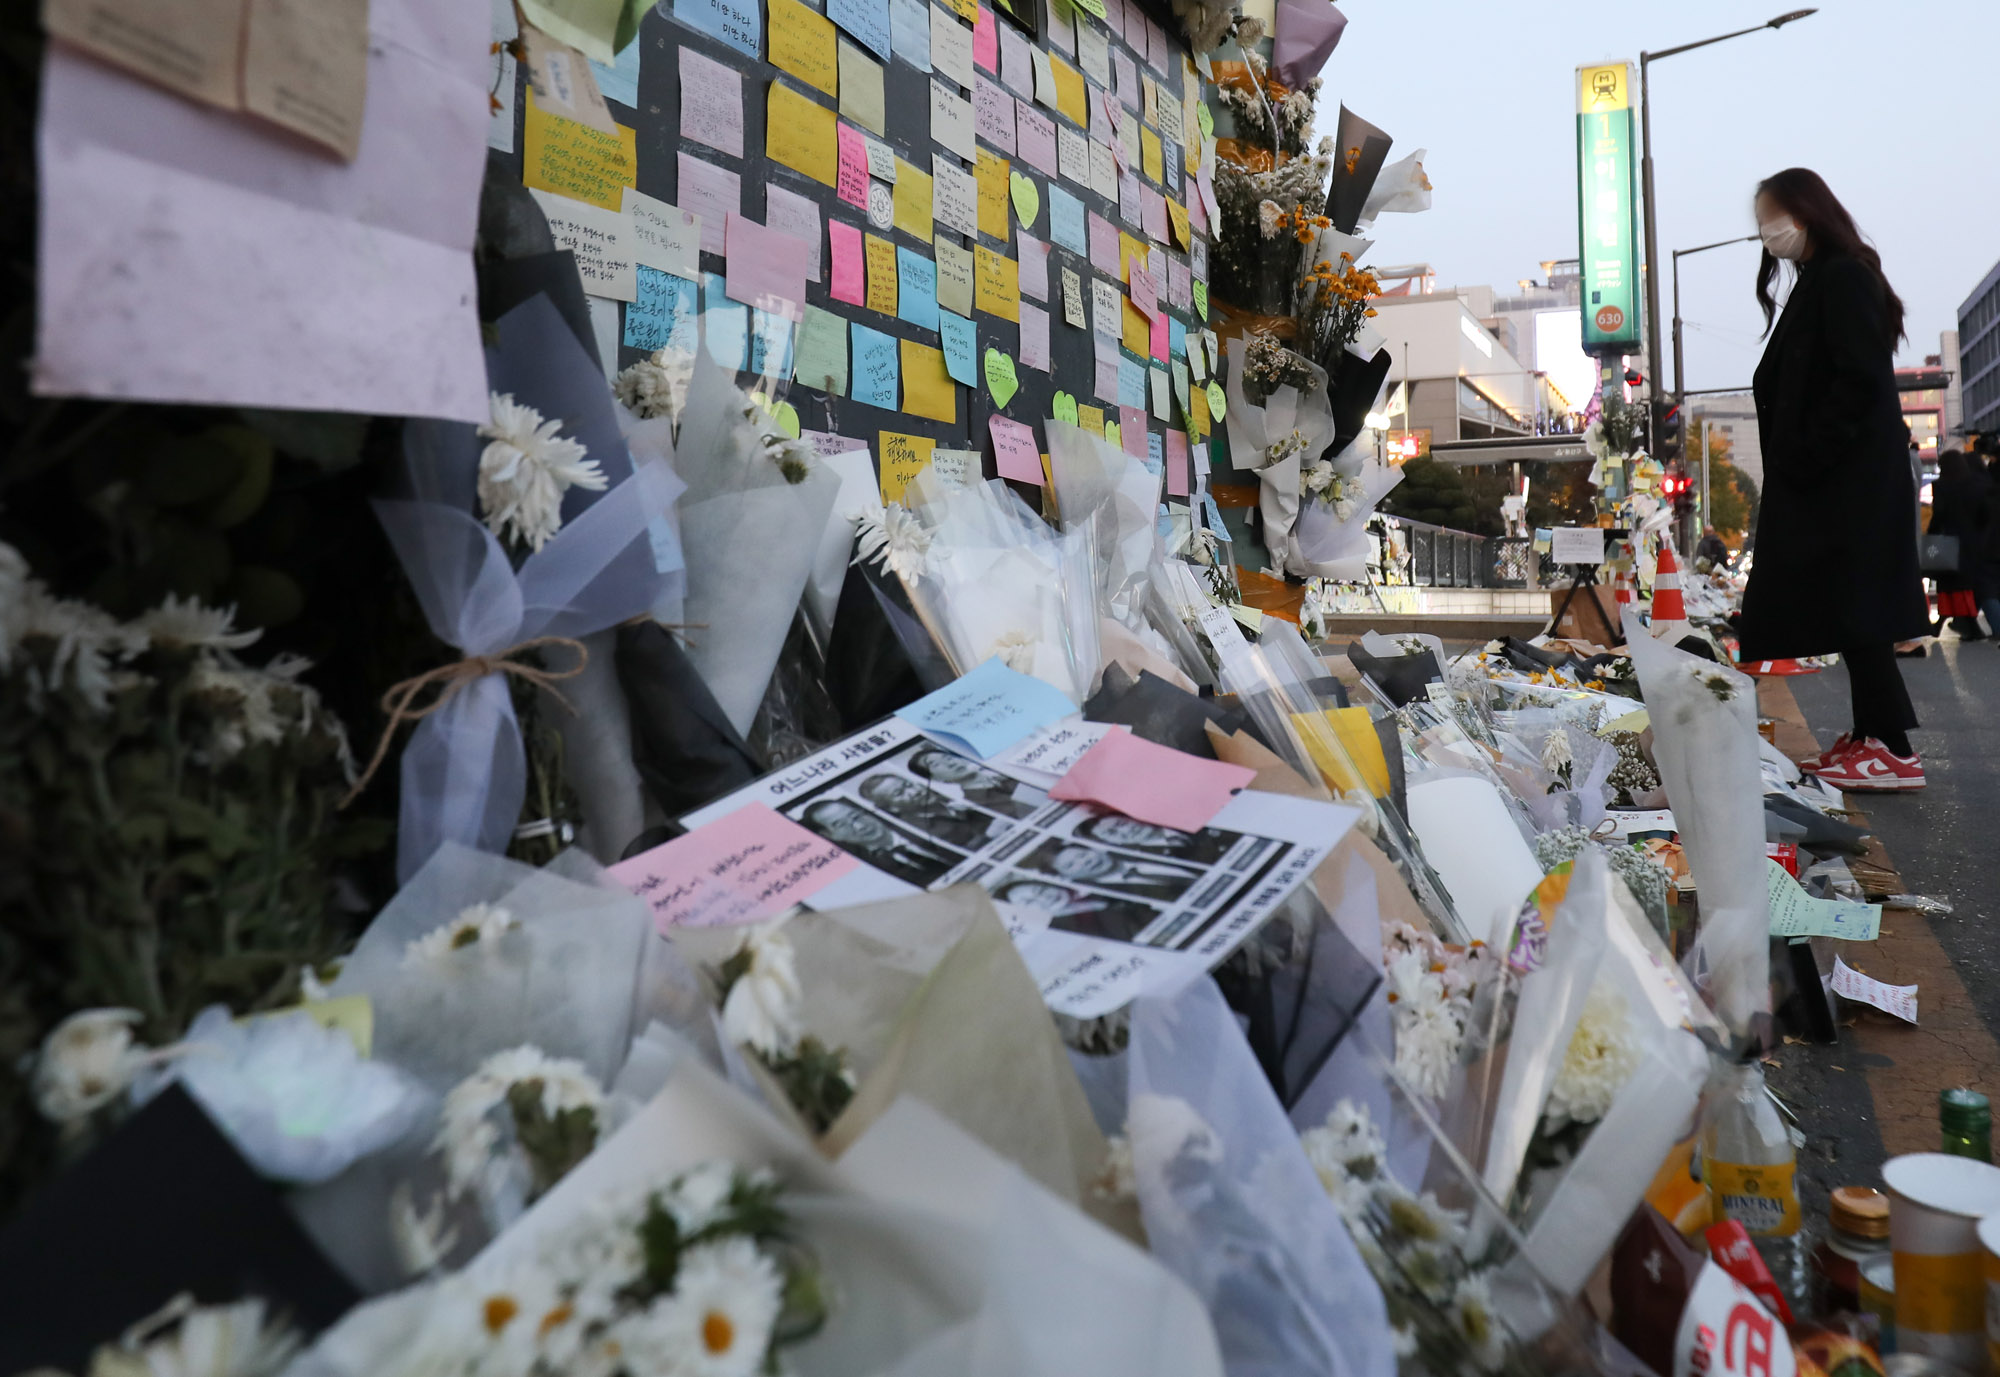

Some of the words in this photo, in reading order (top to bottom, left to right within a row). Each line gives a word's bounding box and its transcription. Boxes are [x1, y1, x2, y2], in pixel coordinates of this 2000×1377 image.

[1600, 114, 1609, 138] 1
[1597, 313, 1622, 325] 630
[841, 730, 896, 760] 사람들?
